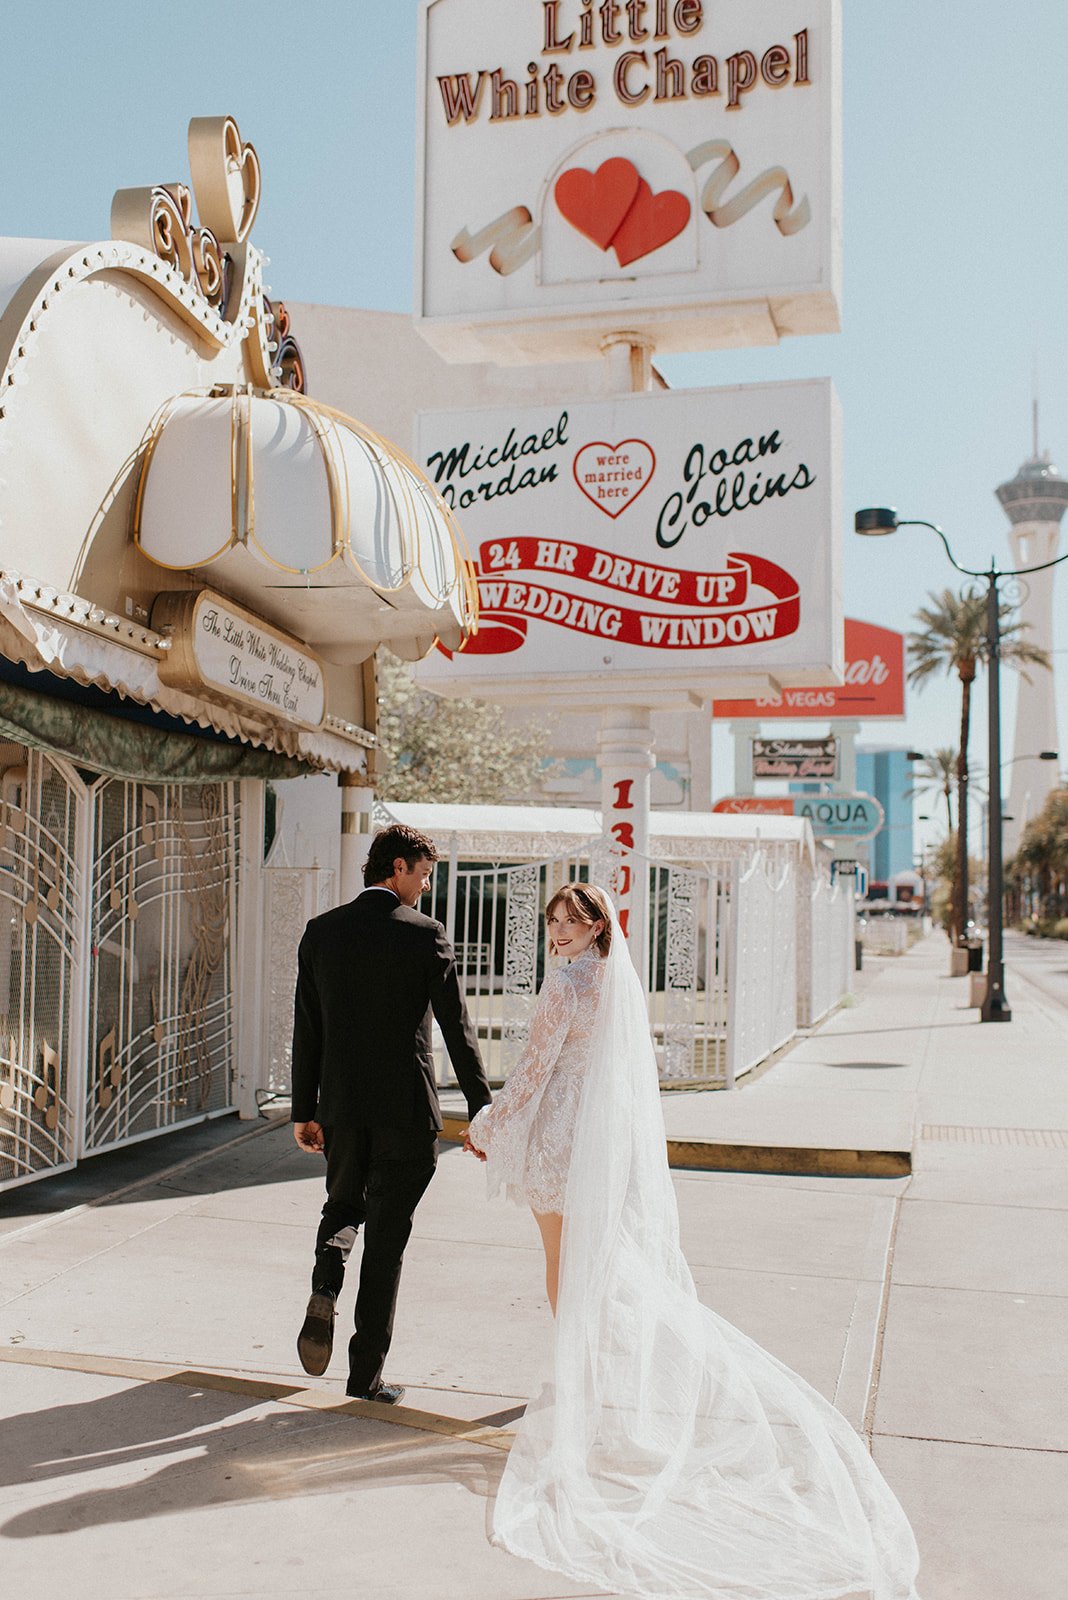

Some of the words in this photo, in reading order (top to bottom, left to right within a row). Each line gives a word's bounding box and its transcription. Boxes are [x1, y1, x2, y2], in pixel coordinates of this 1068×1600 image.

[542, 0, 702, 55] Little
[436, 61, 596, 127] White
[613, 28, 811, 112] Chapel
[427, 411, 569, 483] Michael
[584, 466, 643, 483] married
[596, 454, 630, 467] were
[684, 429, 784, 503] Joan
[597, 486, 630, 499] here
[655, 463, 817, 549] Collins
[489, 541, 521, 570] 24
[534, 540, 578, 573] HR
[588, 552, 681, 600] DRIVE
[695, 574, 737, 603] UP
[479, 582, 623, 637] WEDDING
[639, 607, 779, 646] WINDOW
[202, 610, 220, 637] The
[223, 617, 245, 650] Little
[246, 630, 267, 662] White
[268, 643, 297, 685] Wedding
[297, 658, 319, 692] Chapel
[844, 655, 890, 685] ar
[229, 655, 257, 693] Drive
[258, 674, 281, 705] Thru
[283, 682, 299, 713] Exit
[785, 691, 836, 707] VEGAS
[801, 803, 868, 825] AQUA
